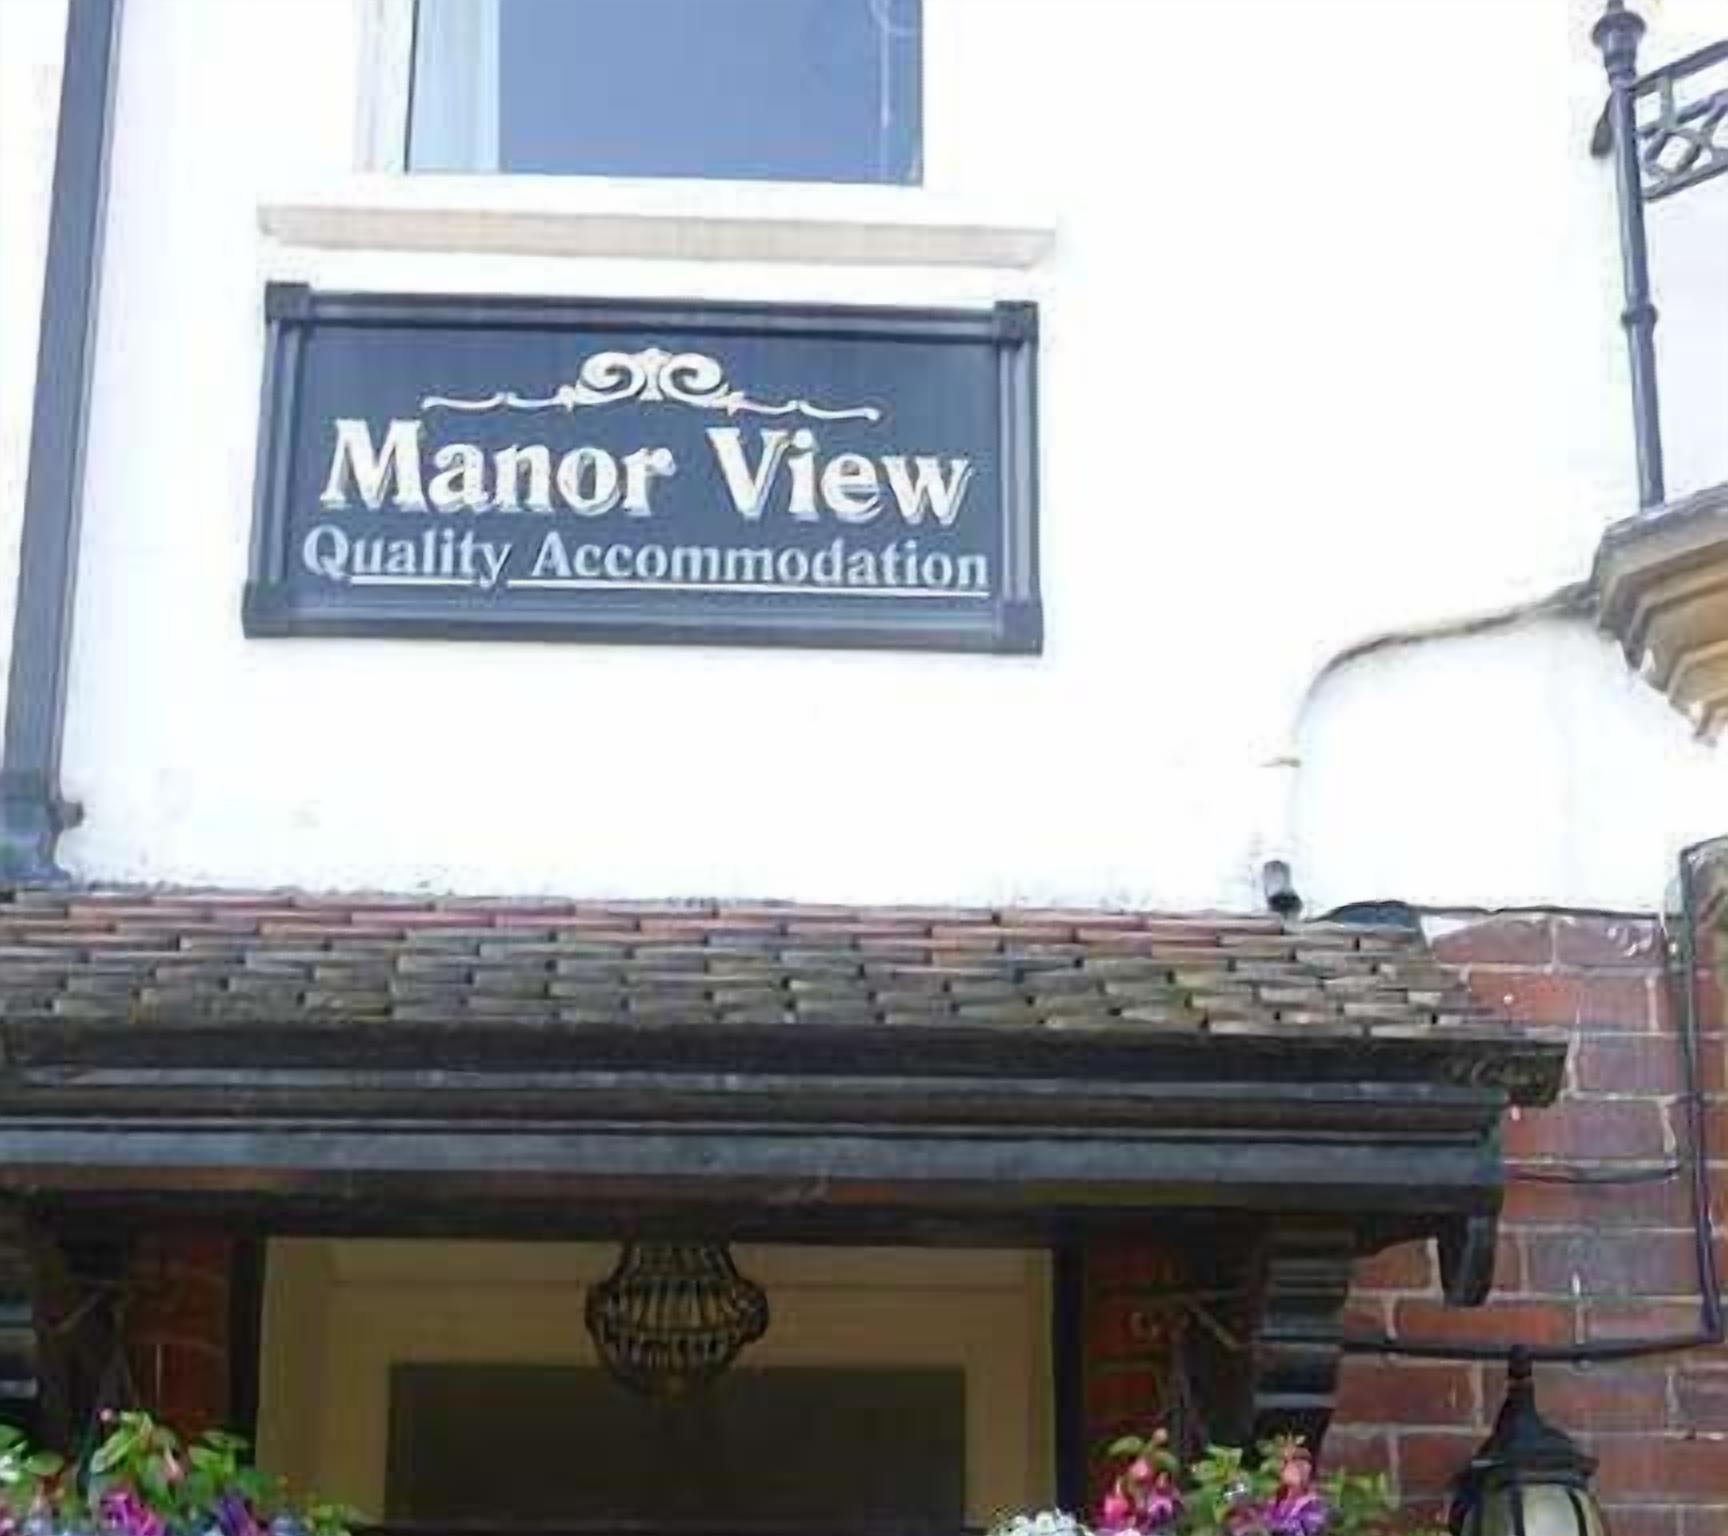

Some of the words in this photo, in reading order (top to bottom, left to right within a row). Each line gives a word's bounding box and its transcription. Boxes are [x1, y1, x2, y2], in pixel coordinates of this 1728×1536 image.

[319, 416, 677, 518] Manor
[704, 422, 974, 528] View
[303, 524, 511, 590] Quality
[531, 531, 990, 588] Accommodation
